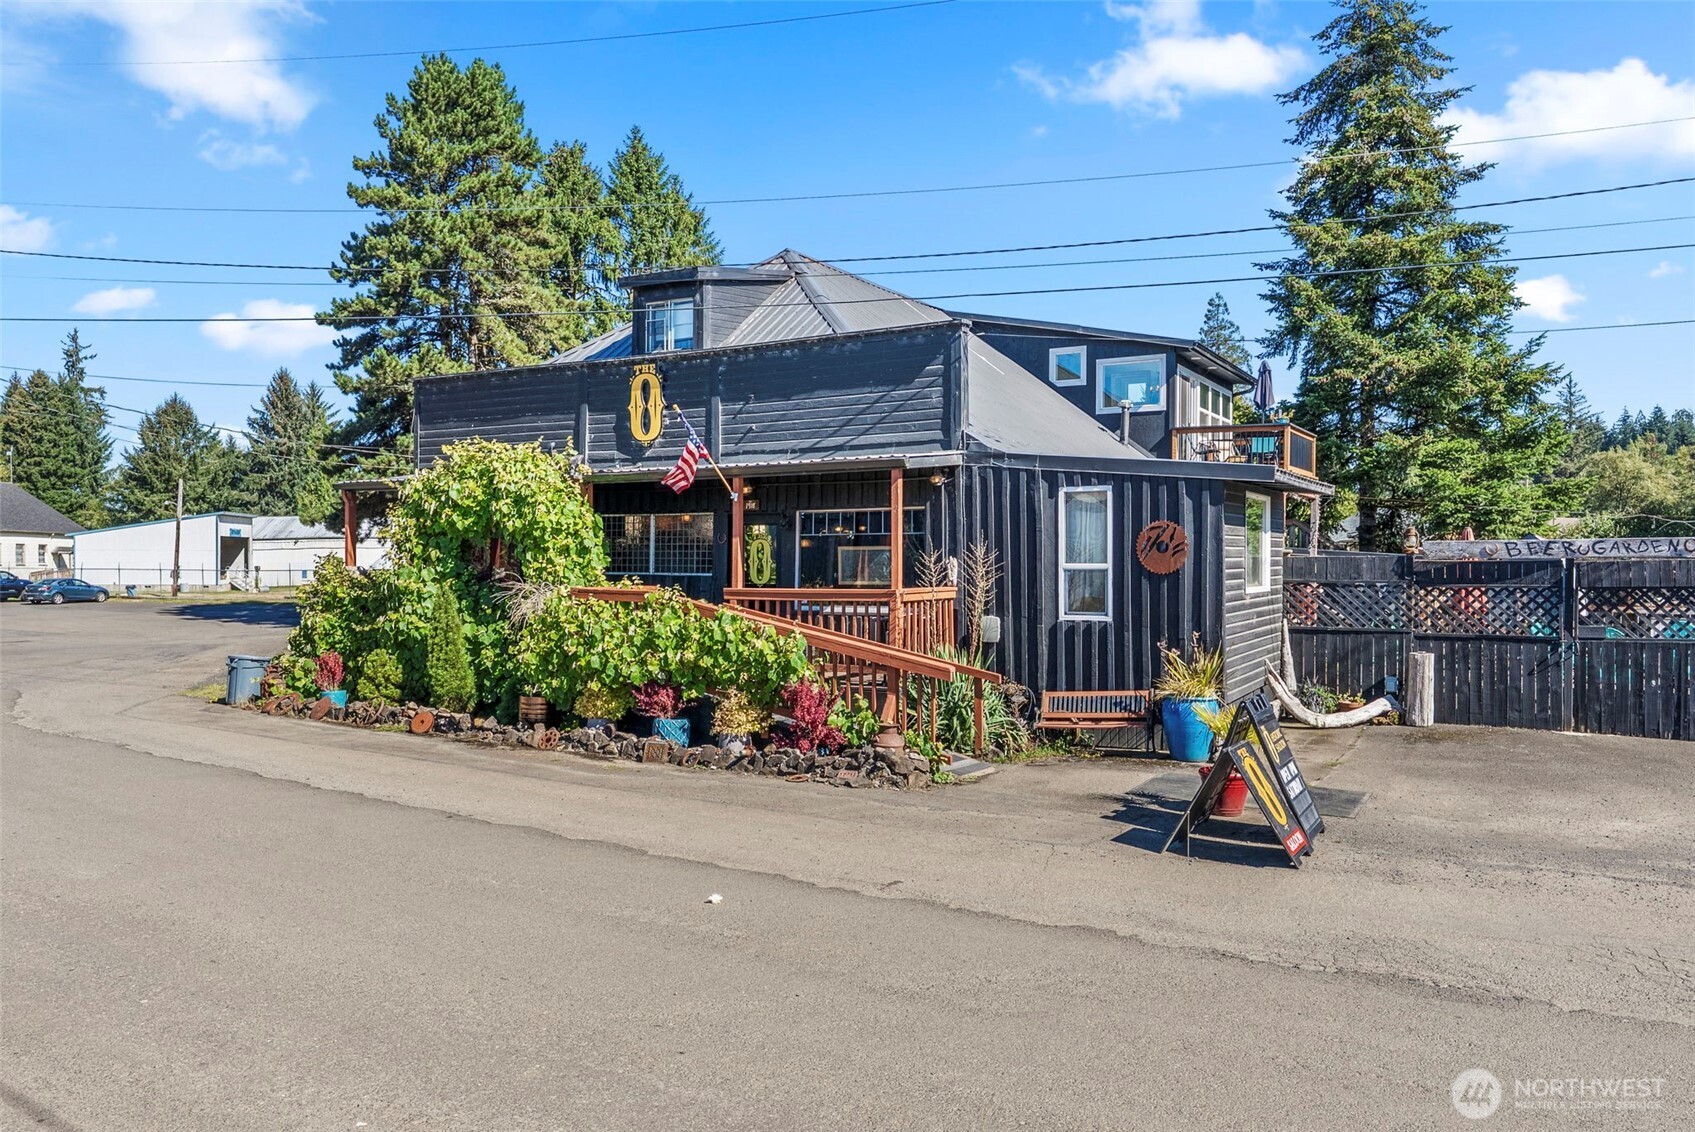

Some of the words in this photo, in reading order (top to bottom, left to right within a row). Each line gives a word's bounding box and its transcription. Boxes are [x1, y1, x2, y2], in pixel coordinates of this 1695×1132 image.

[633, 363, 656, 375] THE
[1504, 540, 1578, 557] BEER
[1591, 538, 1680, 554] GARDEN
